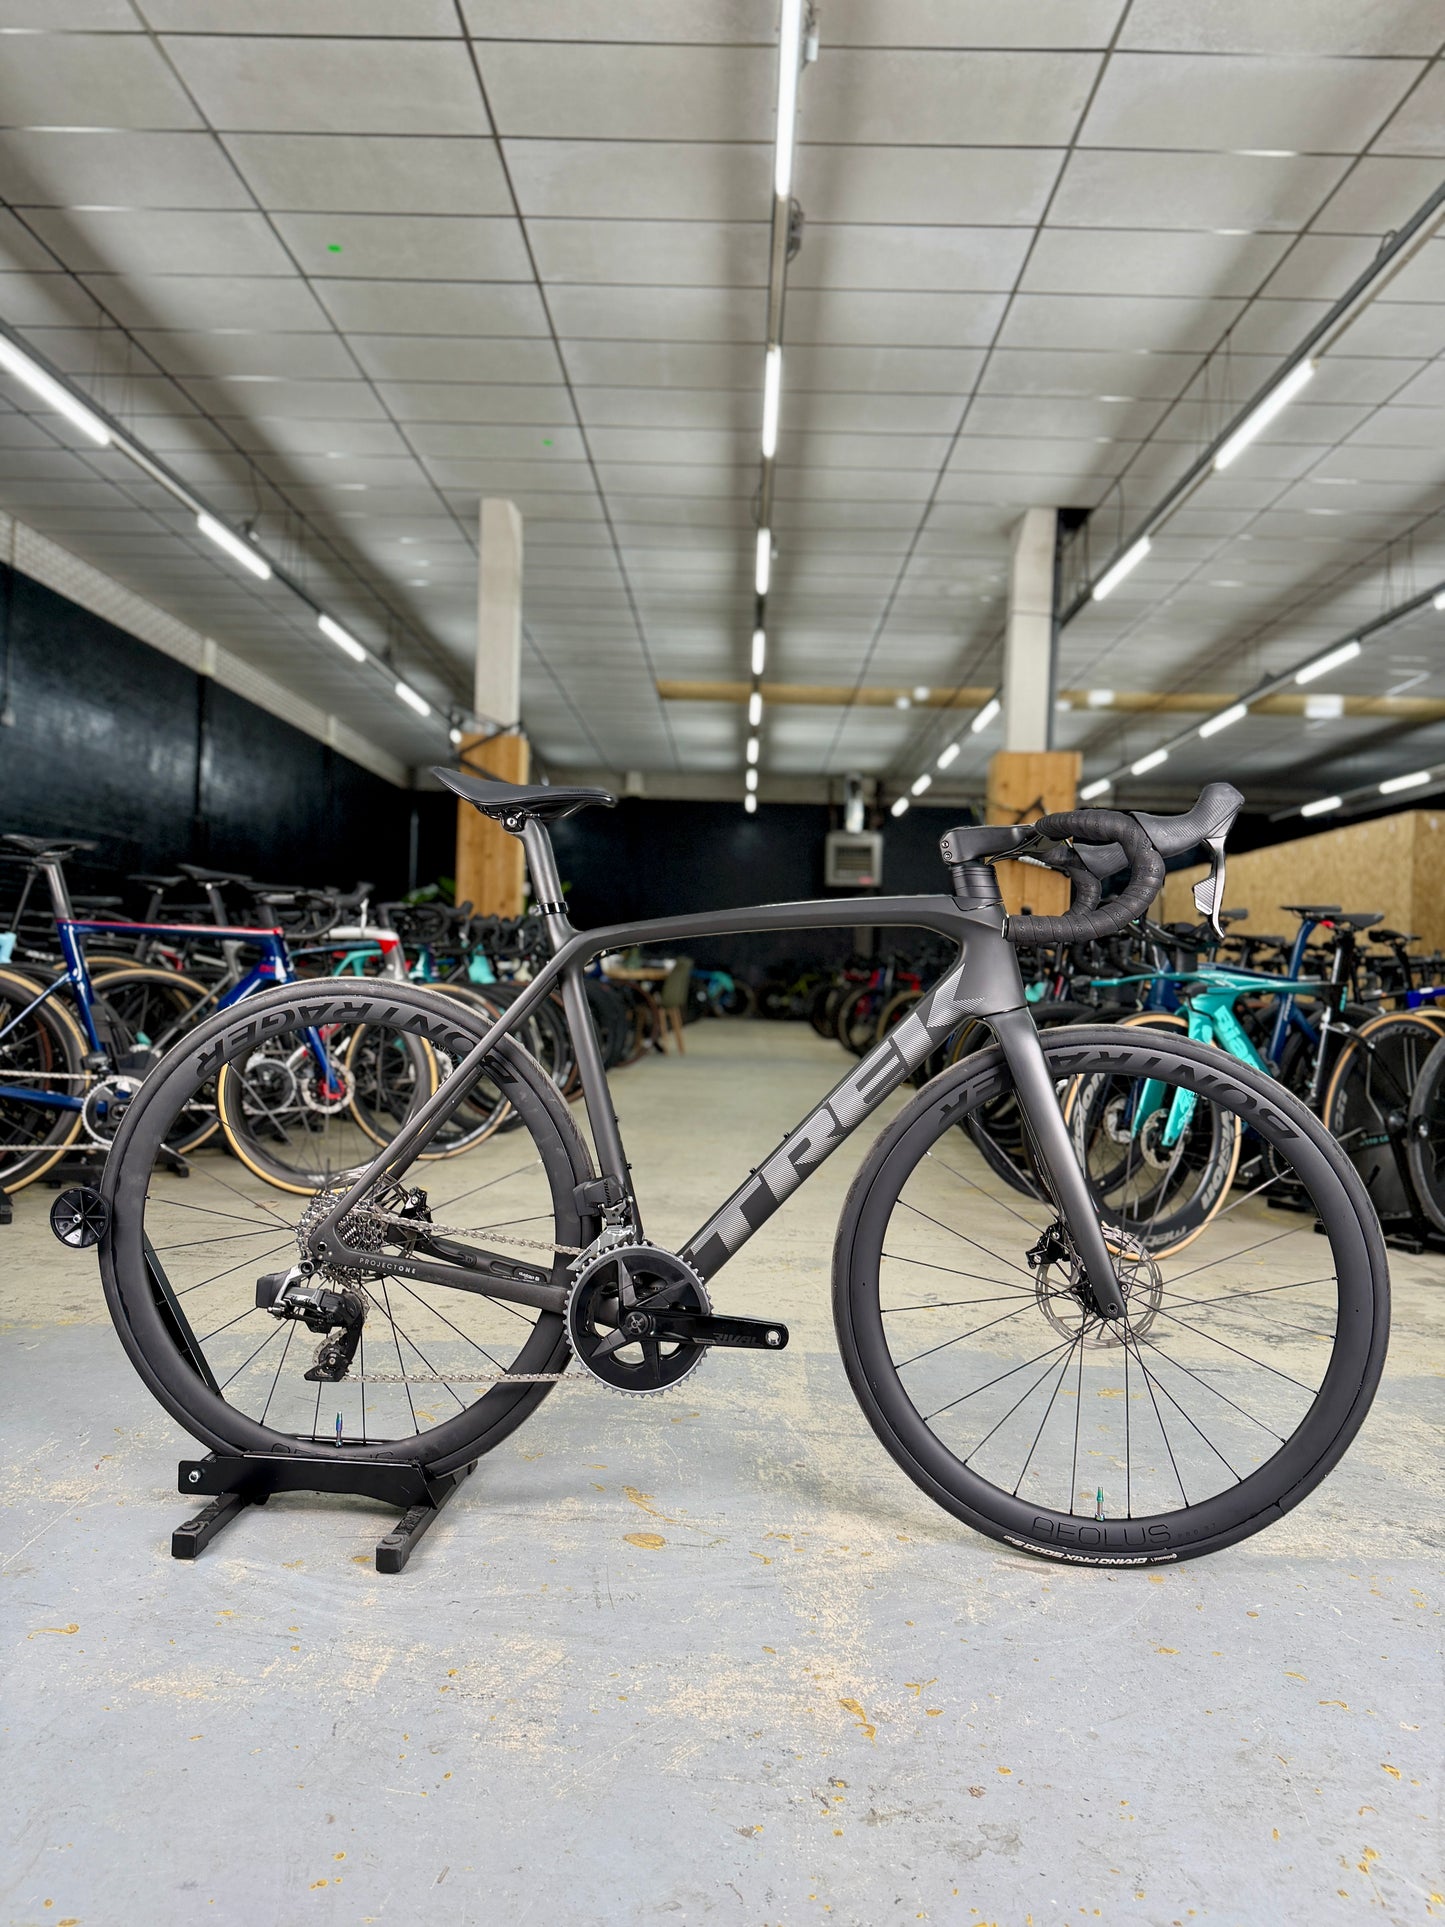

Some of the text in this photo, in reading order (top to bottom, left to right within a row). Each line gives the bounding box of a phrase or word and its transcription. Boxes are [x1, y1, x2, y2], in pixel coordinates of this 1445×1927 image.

[938, 1050, 1303, 1141] BONTRAER
[690, 964, 985, 1255] TREK
[1032, 1516, 1171, 1547] AEOLUS
[1022, 1541, 1065, 1560] 5000
[1063, 1553, 1099, 1564] PRIX
[1098, 1556, 1149, 1565] GRAND
